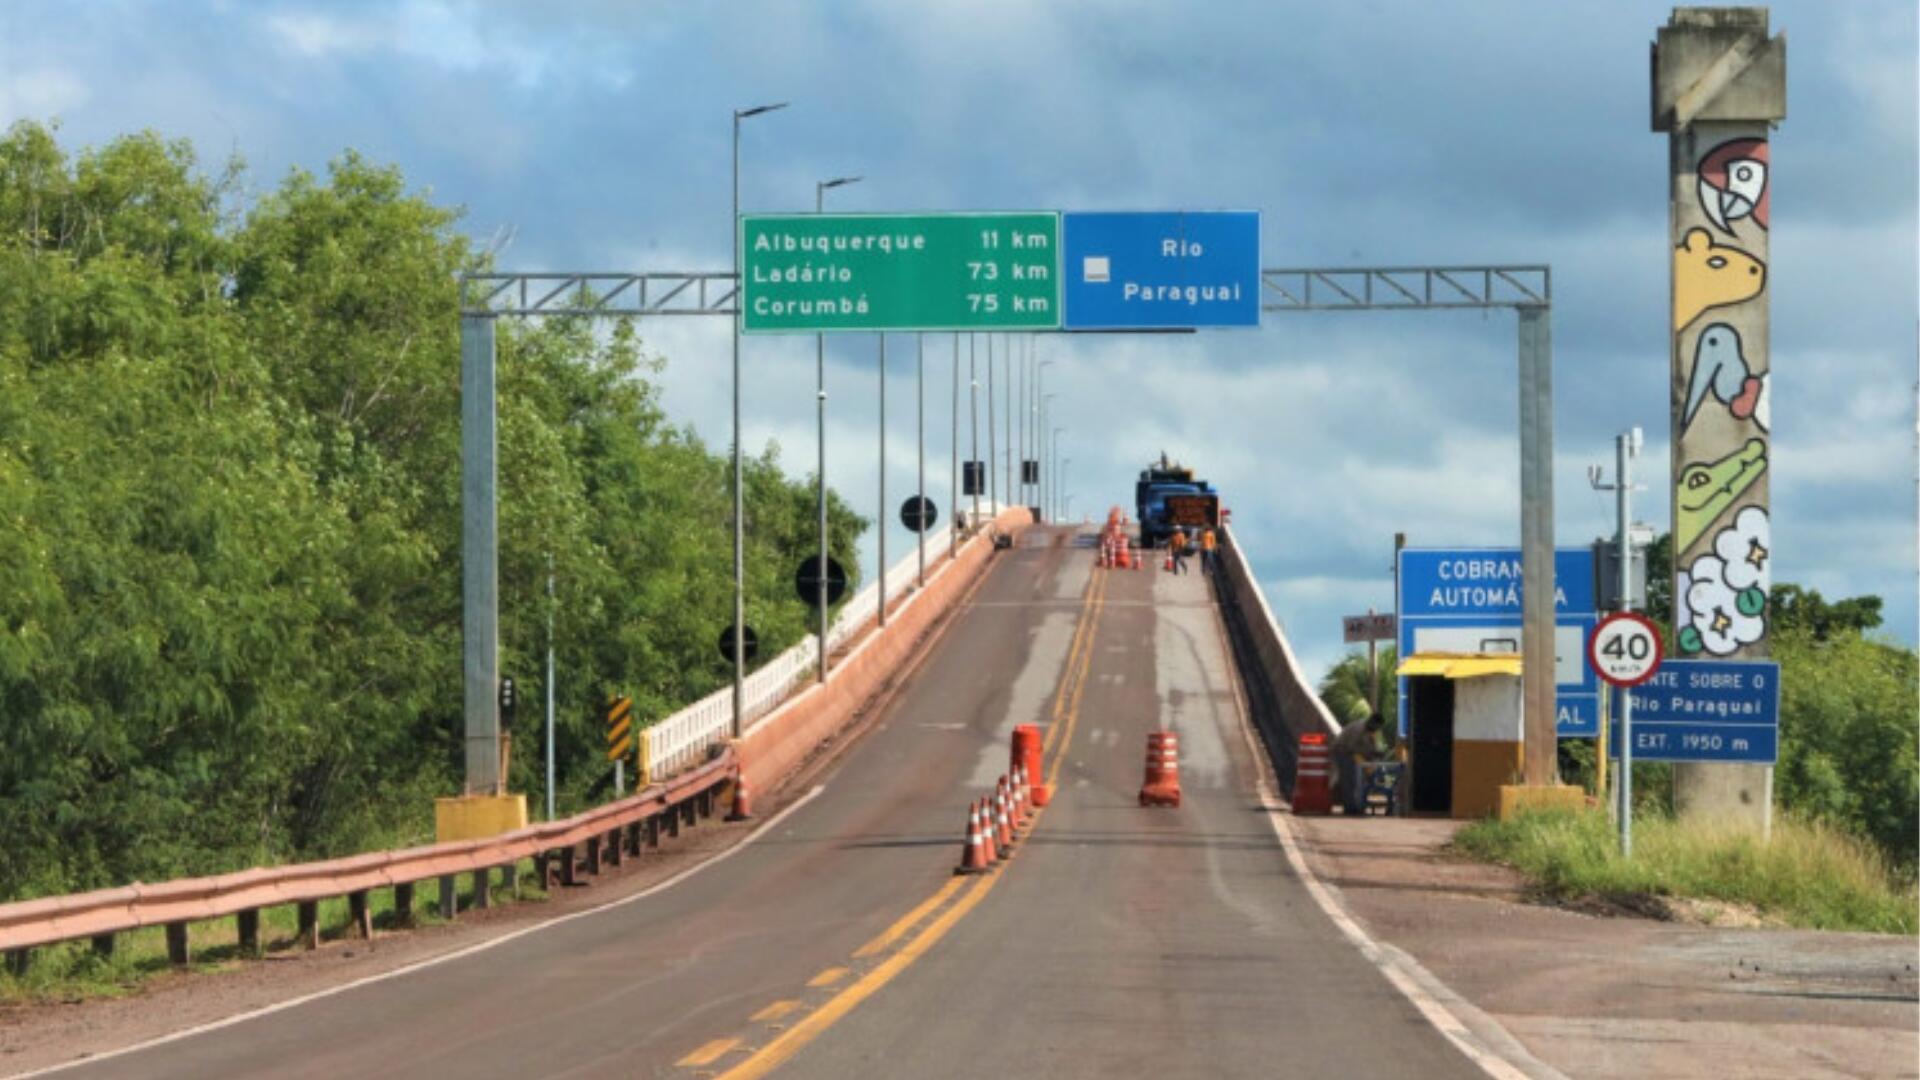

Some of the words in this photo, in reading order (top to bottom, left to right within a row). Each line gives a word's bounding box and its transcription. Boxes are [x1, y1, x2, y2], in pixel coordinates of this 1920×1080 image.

[754, 233, 926, 254] Albuquerque
[981, 230, 998, 249] 11
[1011, 230, 1048, 248] km
[1162, 239, 1203, 257] Rio
[753, 261, 852, 283] Ladário
[967, 262, 998, 280] 73
[1012, 263, 1048, 280] km
[754, 294, 869, 315] Corumbá
[967, 294, 998, 313] 75
[1012, 295, 1049, 312] km
[1124, 283, 1240, 305] Paraguai
[1430, 583, 1569, 607] AUTOMÁA
[1602, 633, 1649, 660] 40
[1690, 674, 1743, 689] SOBRE
[1631, 695, 1660, 711] Rio
[1671, 697, 1762, 717] Paraguai
[1683, 733, 1723, 750] 1950
[1732, 738, 1749, 751] m
